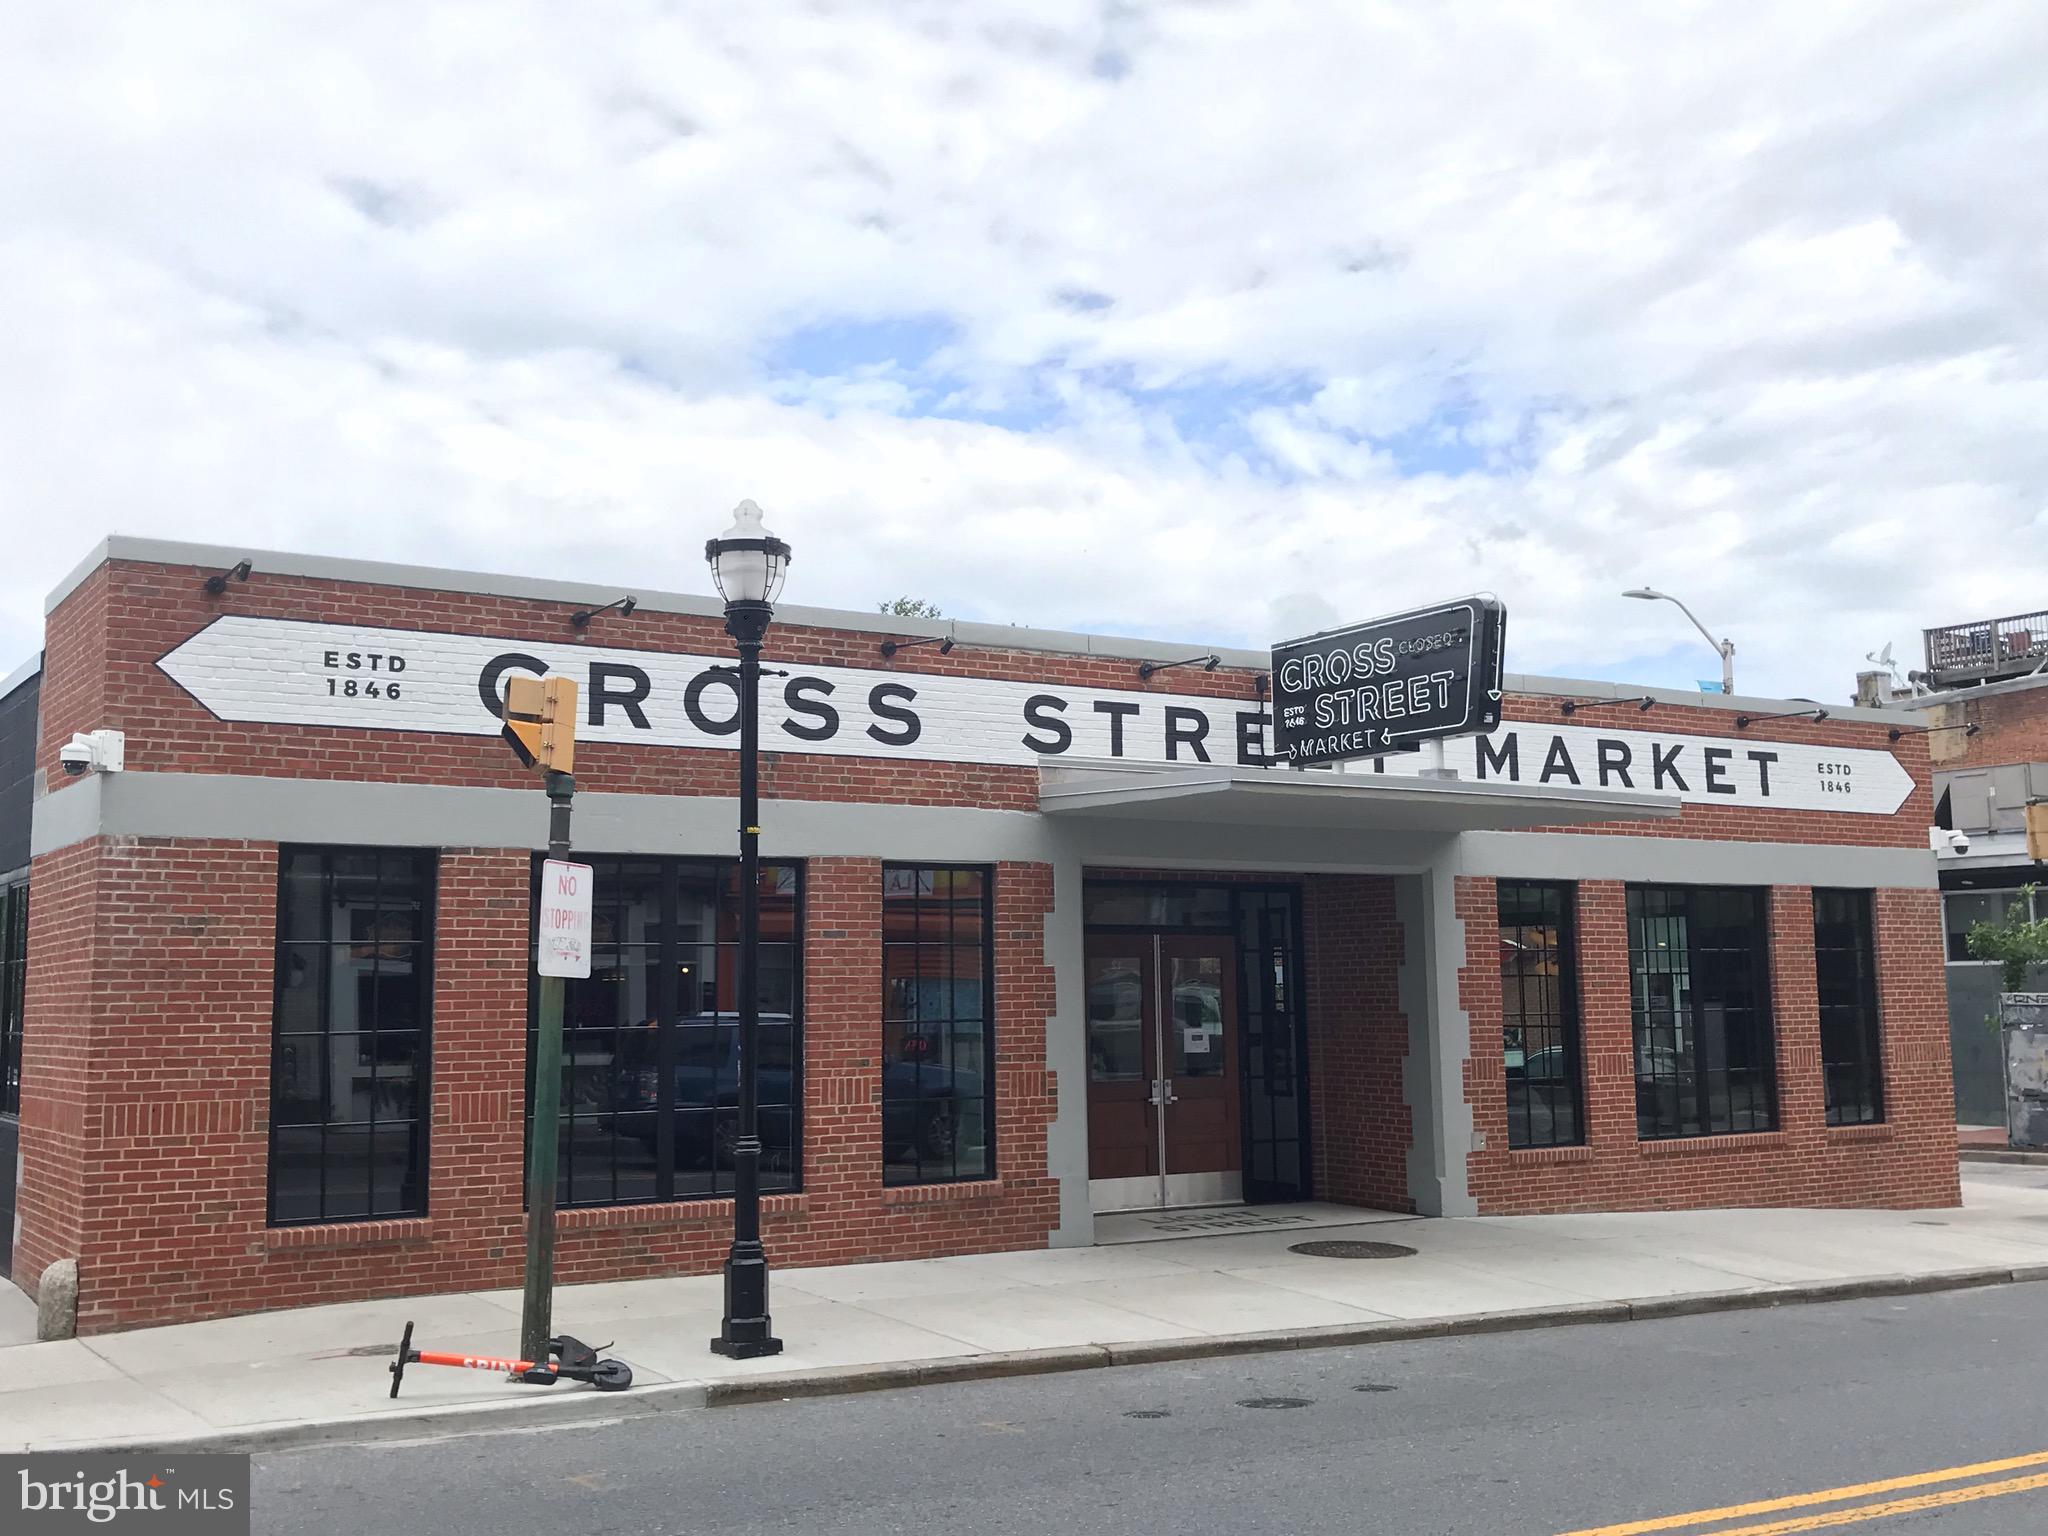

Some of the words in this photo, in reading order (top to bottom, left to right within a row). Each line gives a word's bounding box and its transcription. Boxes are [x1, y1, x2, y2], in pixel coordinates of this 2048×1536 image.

[1398, 631, 1452, 654] CLOSED
[324, 650, 406, 673] ESTD
[1280, 637, 1396, 693] CROSS
[326, 678, 401, 700] 1846
[1314, 670, 1455, 729] STREET
[478, 652, 922, 747] CROSS
[1021, 693, 1385, 773] STRE
[1475, 732, 1779, 797] MARKET
[1300, 729, 1376, 757] MARKET
[1817, 762, 1852, 776] ESTD
[1820, 780, 1852, 794] 1846
[558, 875, 577, 896] NO
[1153, 1215, 1316, 1232] STREET
